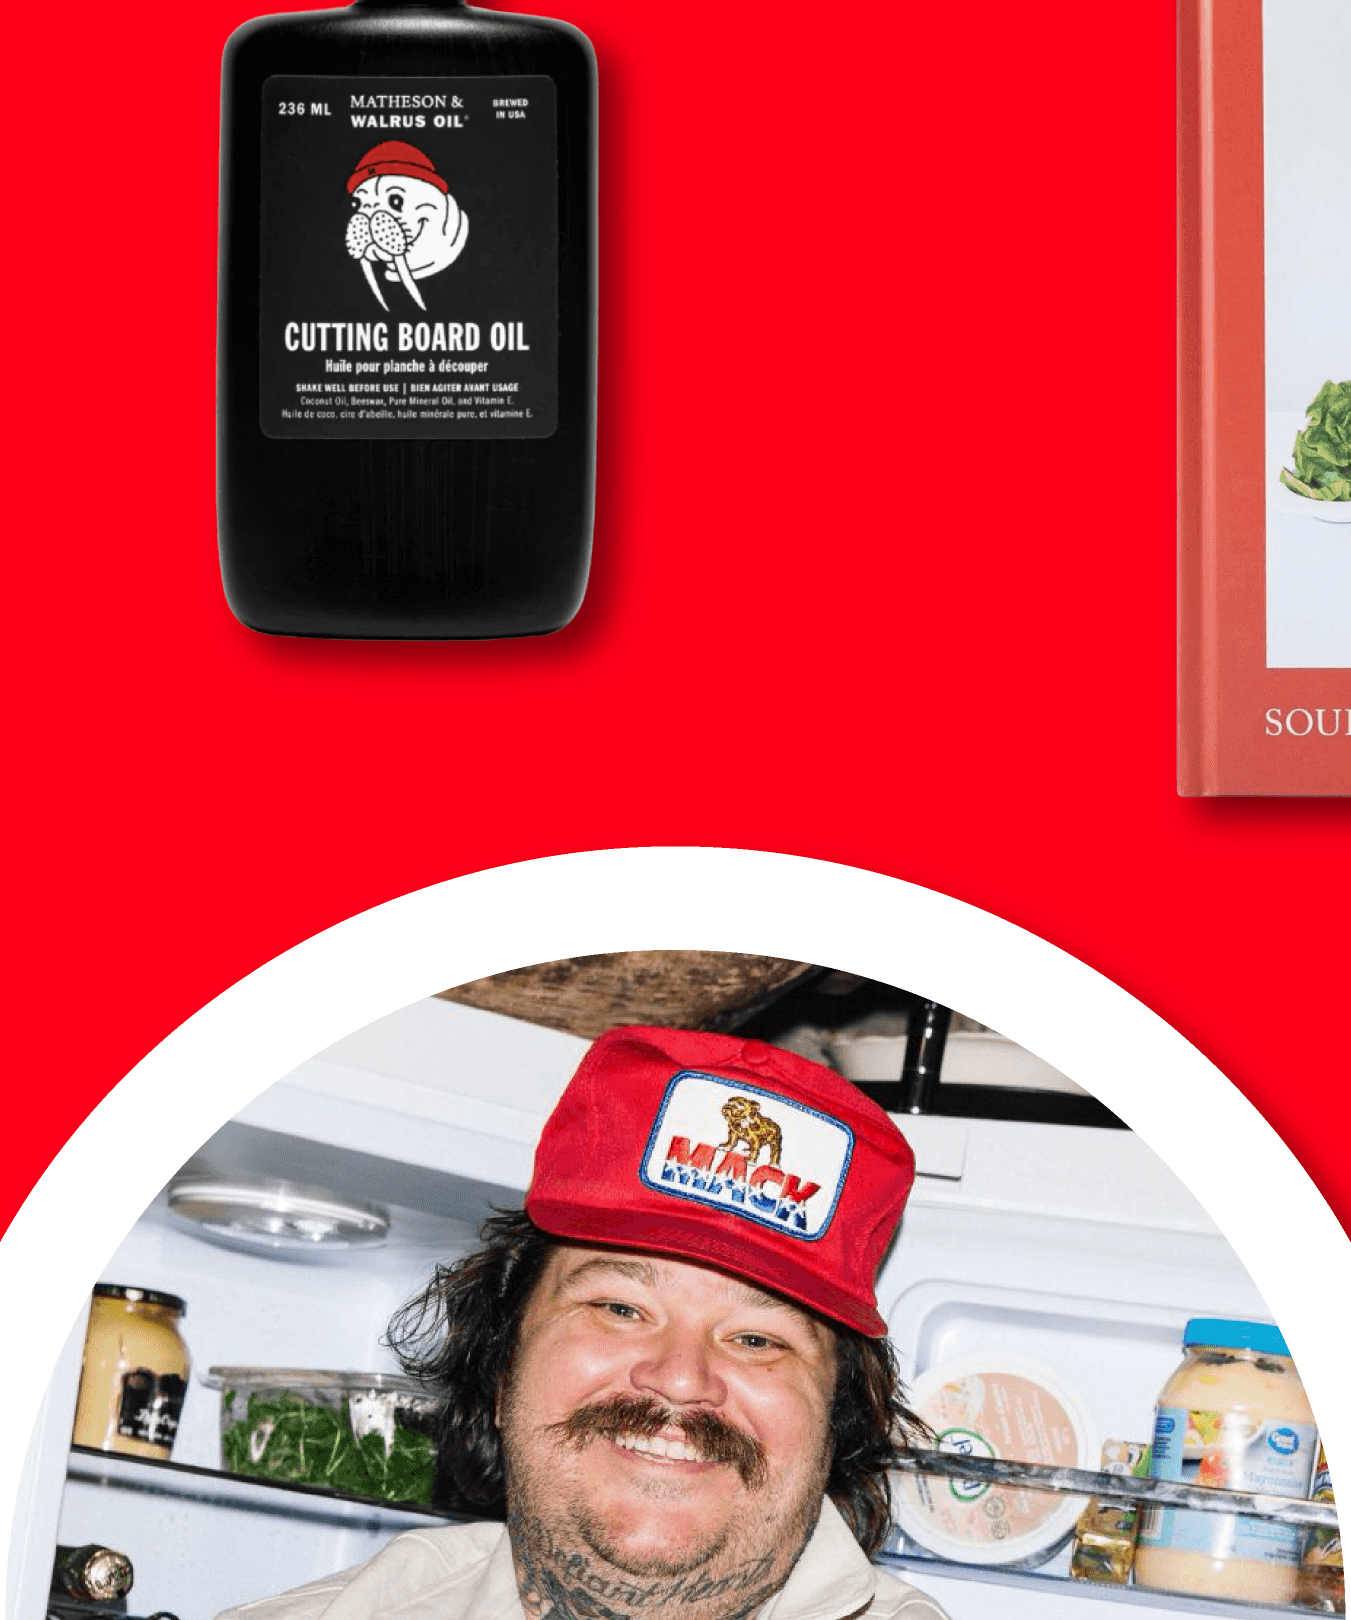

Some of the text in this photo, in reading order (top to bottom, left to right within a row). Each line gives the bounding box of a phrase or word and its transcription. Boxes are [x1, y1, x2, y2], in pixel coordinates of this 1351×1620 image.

[279, 102, 332, 116] 236 ML
[350, 95, 464, 109] MATHESON &
[493, 98, 529, 108] BREWED
[351, 115, 426, 128] WALRUS
[496, 111, 526, 119] IN USA
[284, 321, 530, 352] CUTTING BOARD OIL
[325, 358, 488, 376] Huile pour planche à découper
[296, 383, 519, 392] SHAKE WELL BEFORE USE BIEN AGITER AVANT USAGE
[661, 1135, 821, 1231] MACK
